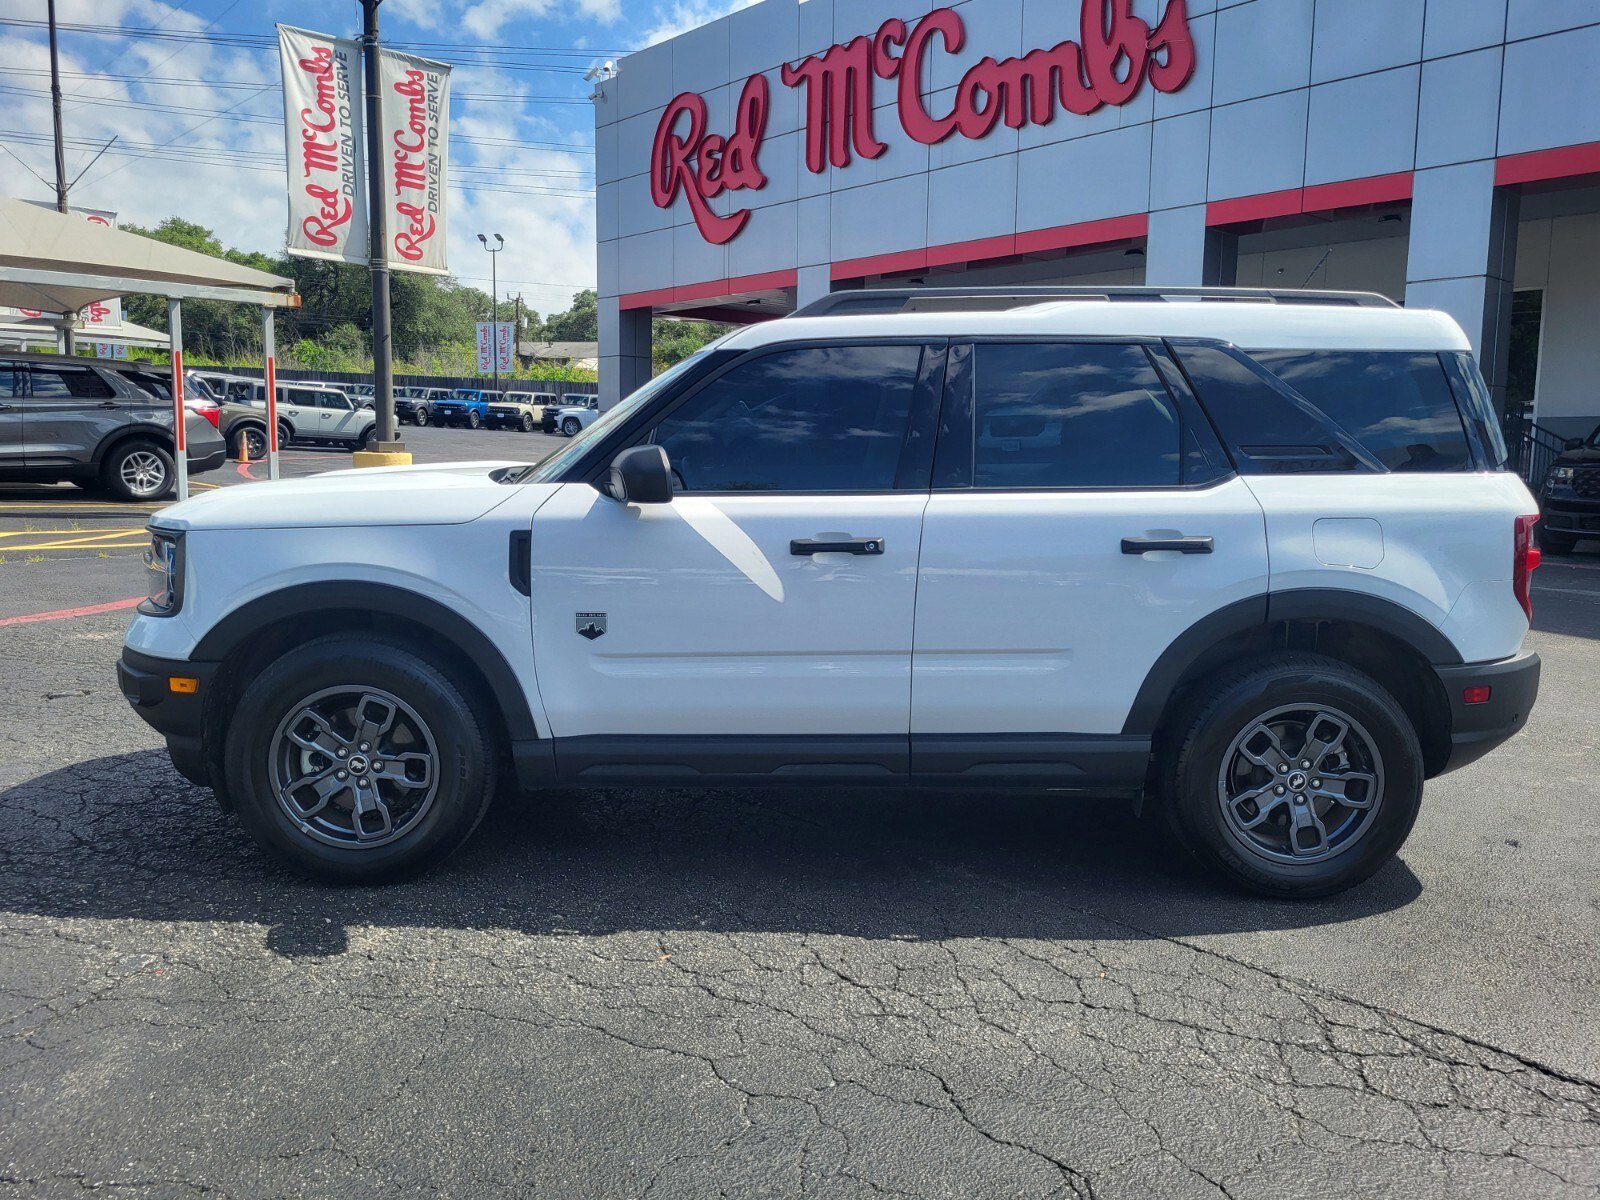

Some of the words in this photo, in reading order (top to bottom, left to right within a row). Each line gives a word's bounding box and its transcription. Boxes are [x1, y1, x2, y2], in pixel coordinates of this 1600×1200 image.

[335, 50, 350, 103] SERVE
[426, 72, 439, 124] SERVE
[298, 46, 339, 178] McCombs
[338, 105, 352, 130] TO
[393, 70, 426, 197] McCombs
[427, 127, 439, 149] TO
[651, 74, 768, 245] Red
[781, 0, 1195, 174] McCombs
[340, 134, 355, 197] DRIVEN
[427, 155, 439, 214] DRIVEN
[303, 184, 352, 247] Red
[394, 202, 436, 261] Red
